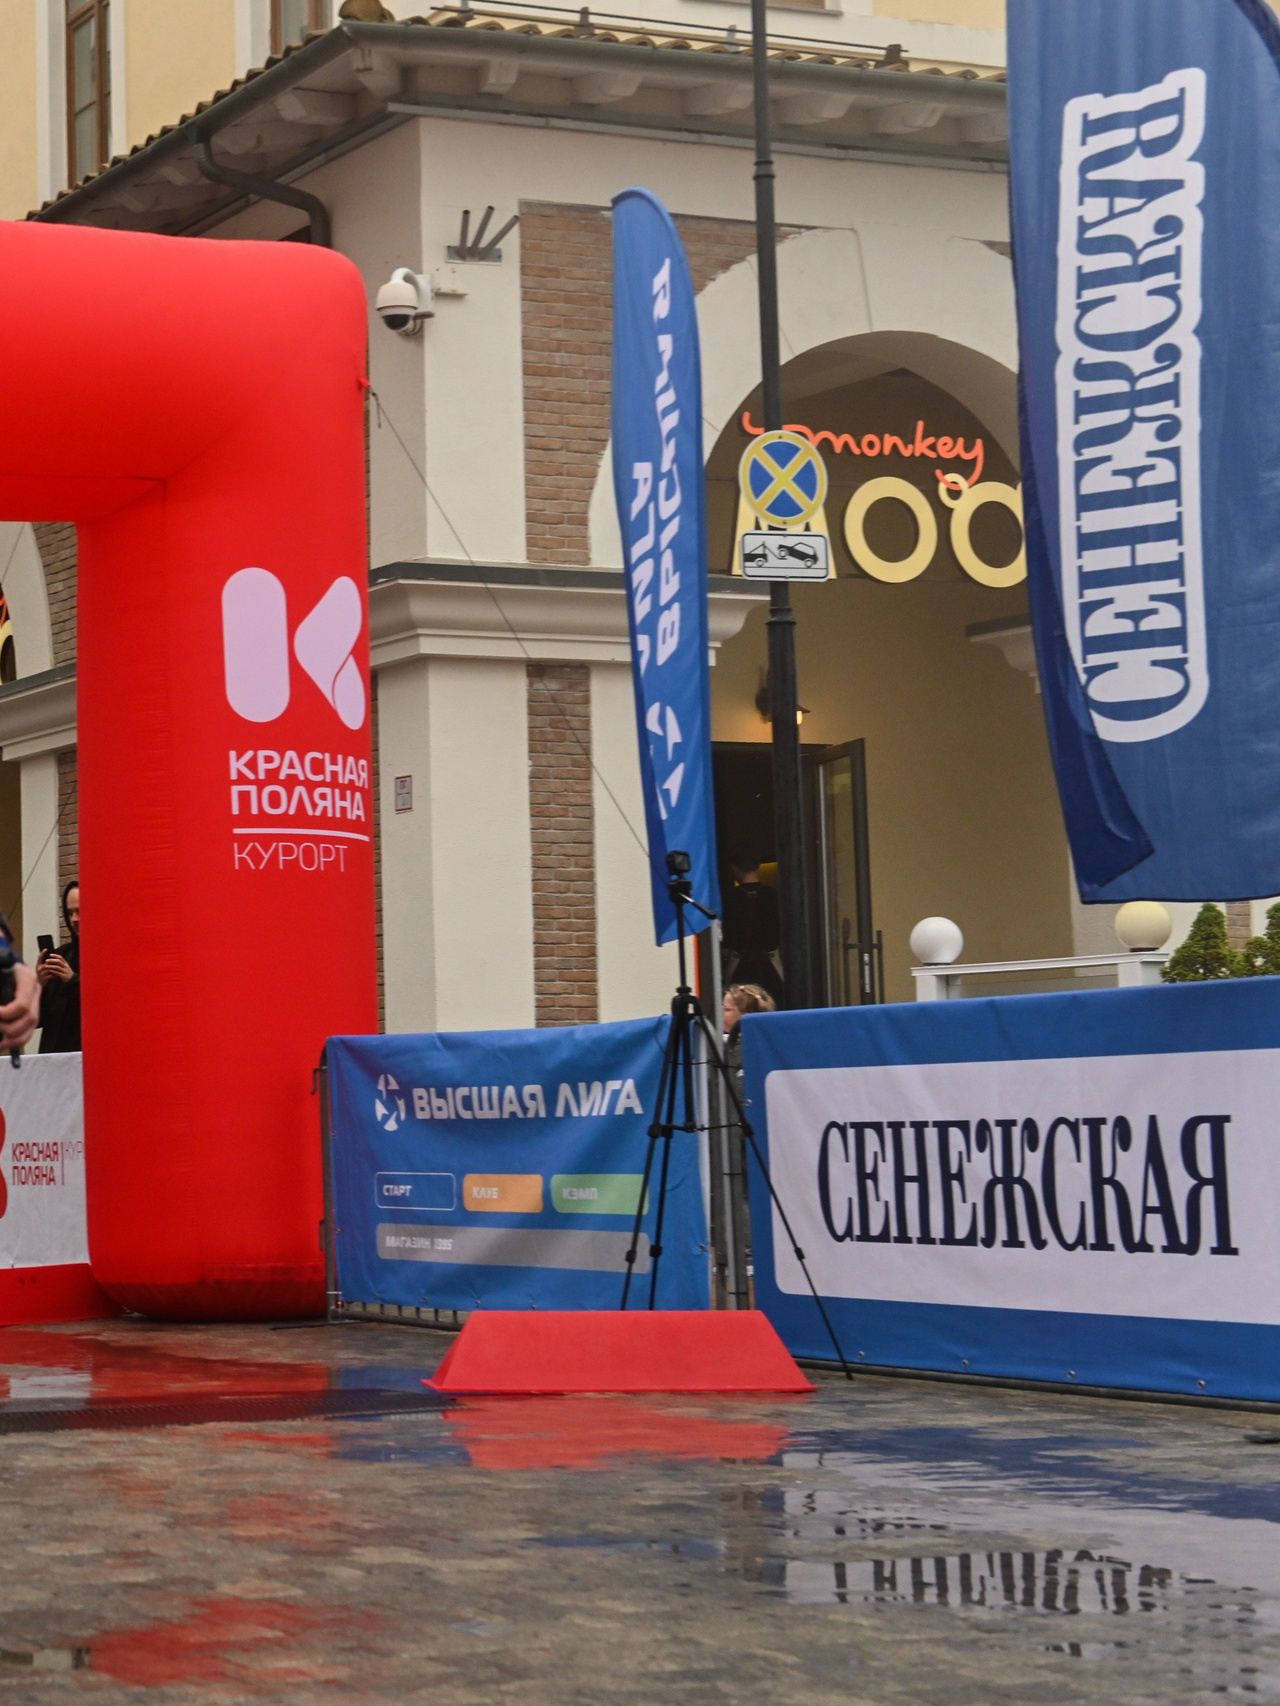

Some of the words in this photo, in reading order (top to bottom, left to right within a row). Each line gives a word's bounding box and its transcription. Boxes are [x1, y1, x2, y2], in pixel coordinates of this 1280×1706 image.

[228, 750, 369, 789] КРАСНАЯ
[230, 784, 366, 823] ПОЛЯНА
[233, 842, 349, 873] КУРОРТ
[412, 1085, 547, 1121] ВЫСШАЯ
[555, 1078, 644, 1118] ЛИГА
[11, 1141, 59, 1163] КРАСНАЯ
[12, 1165, 57, 1186] ПОЛЯНА
[818, 1114, 1240, 1257] СЕНЕЖСКАЯ
[382, 1184, 413, 1197] СТАРТ
[472, 1186, 499, 1200] КЛУБ
[562, 1186, 599, 1201] КЭМП
[385, 1235, 432, 1249] МАГАЗИН
